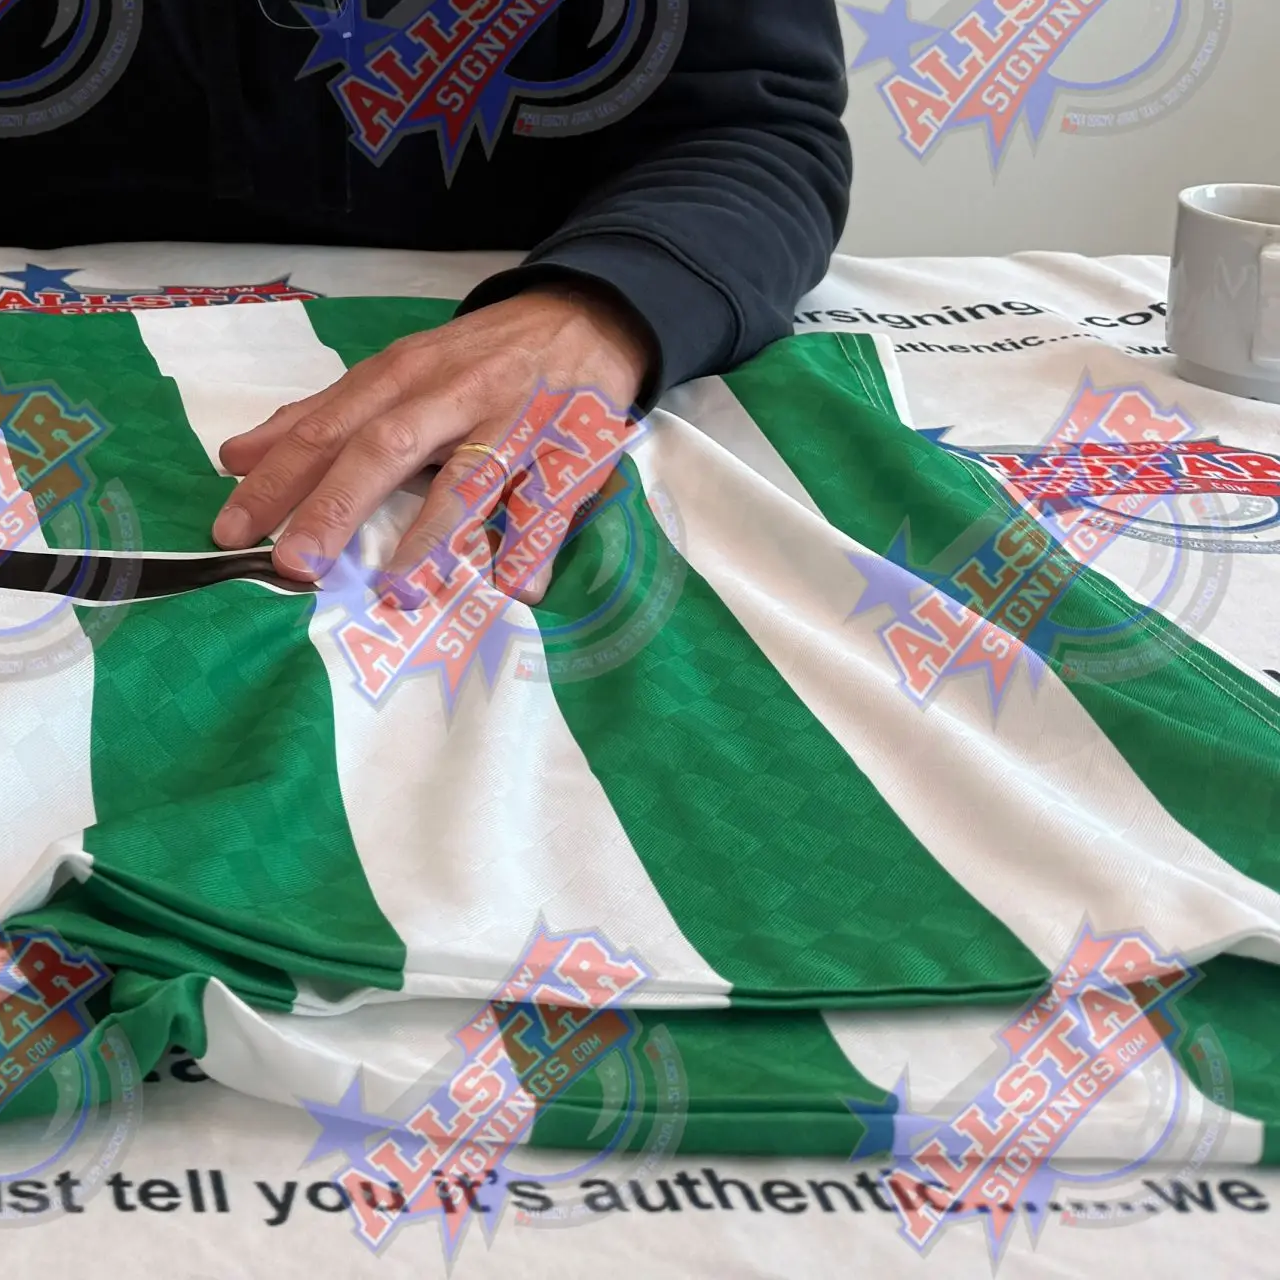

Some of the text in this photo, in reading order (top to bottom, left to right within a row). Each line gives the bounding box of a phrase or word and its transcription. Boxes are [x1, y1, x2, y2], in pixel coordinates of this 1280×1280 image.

[981, 453, 1280, 482] LSTAR
[107, 1168, 229, 1213] tell
[254, 1179, 410, 1226] you
[432, 1168, 555, 1213] it's
